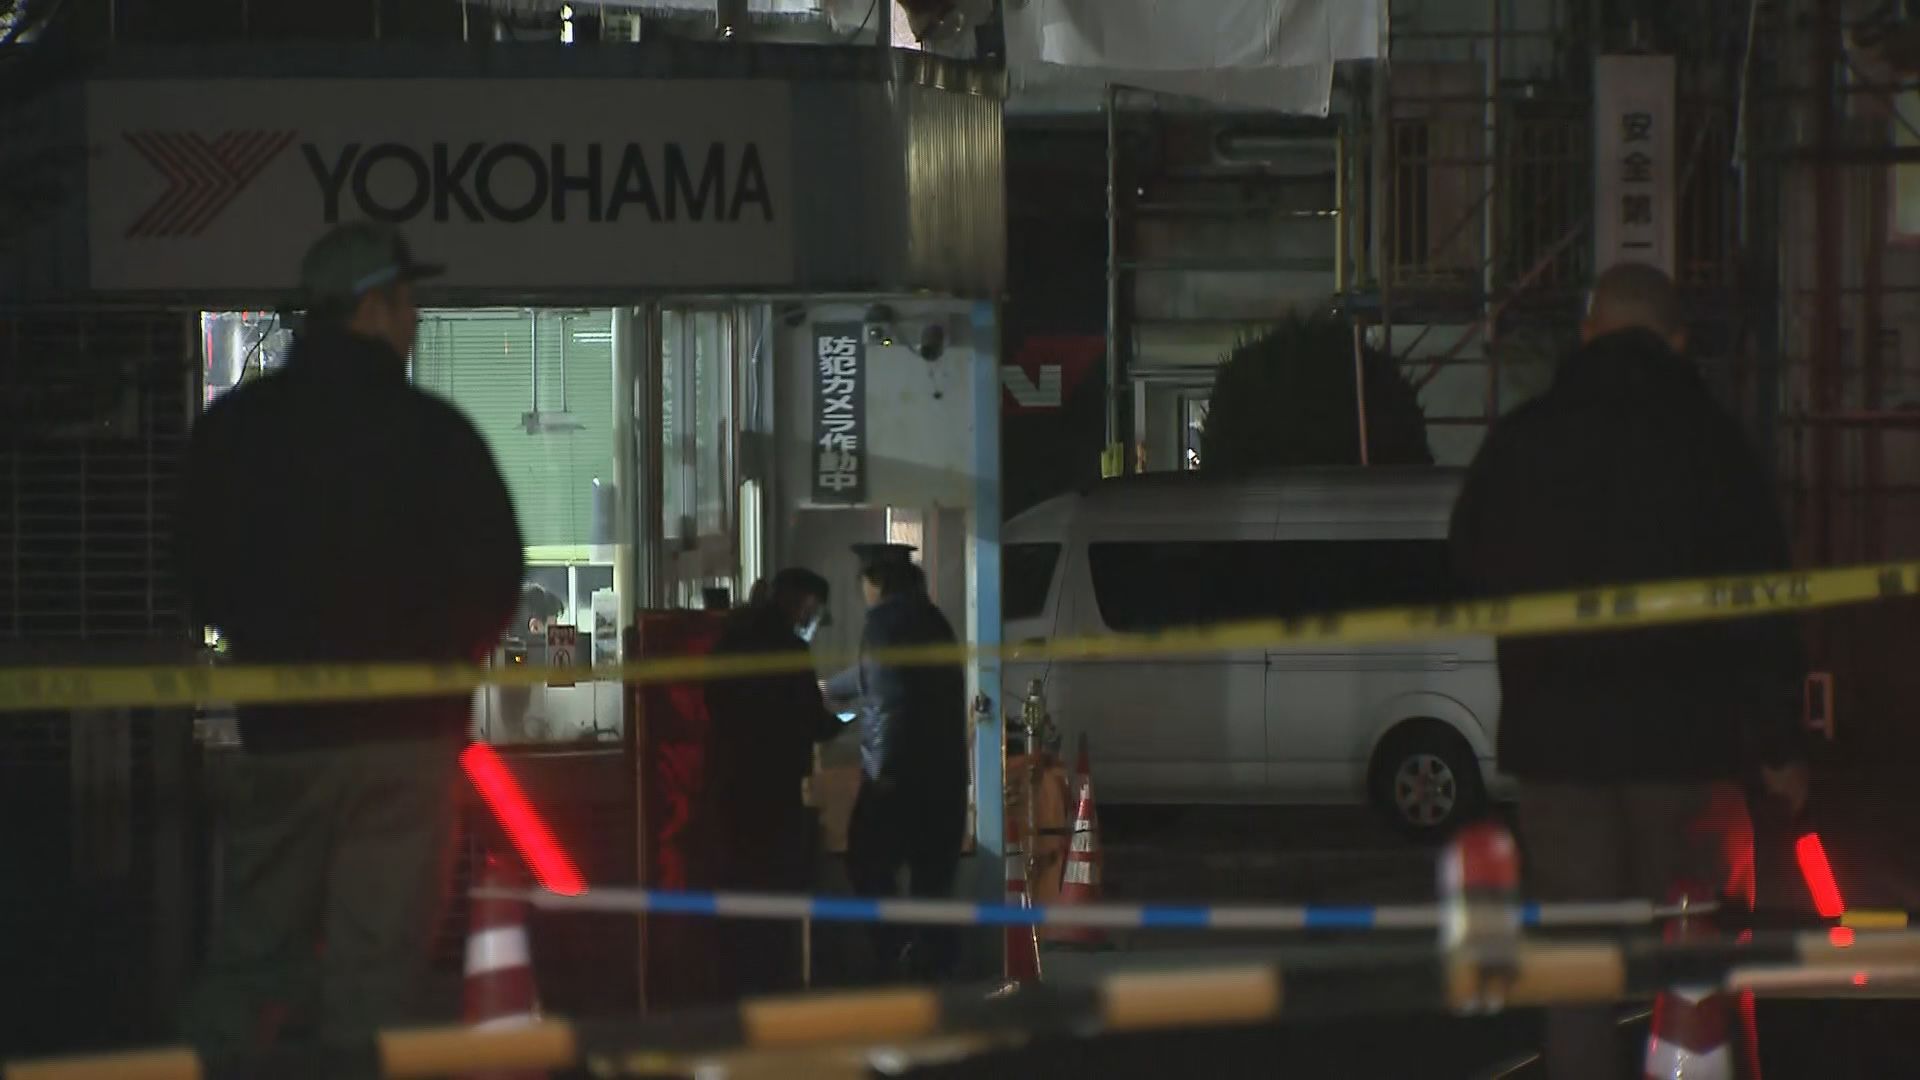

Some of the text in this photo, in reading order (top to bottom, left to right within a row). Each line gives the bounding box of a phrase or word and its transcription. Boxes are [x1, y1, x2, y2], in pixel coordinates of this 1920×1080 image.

[302, 142, 773, 223] YOKOHAMA
[818, 336, 858, 491] 防犯カメラ作動中
